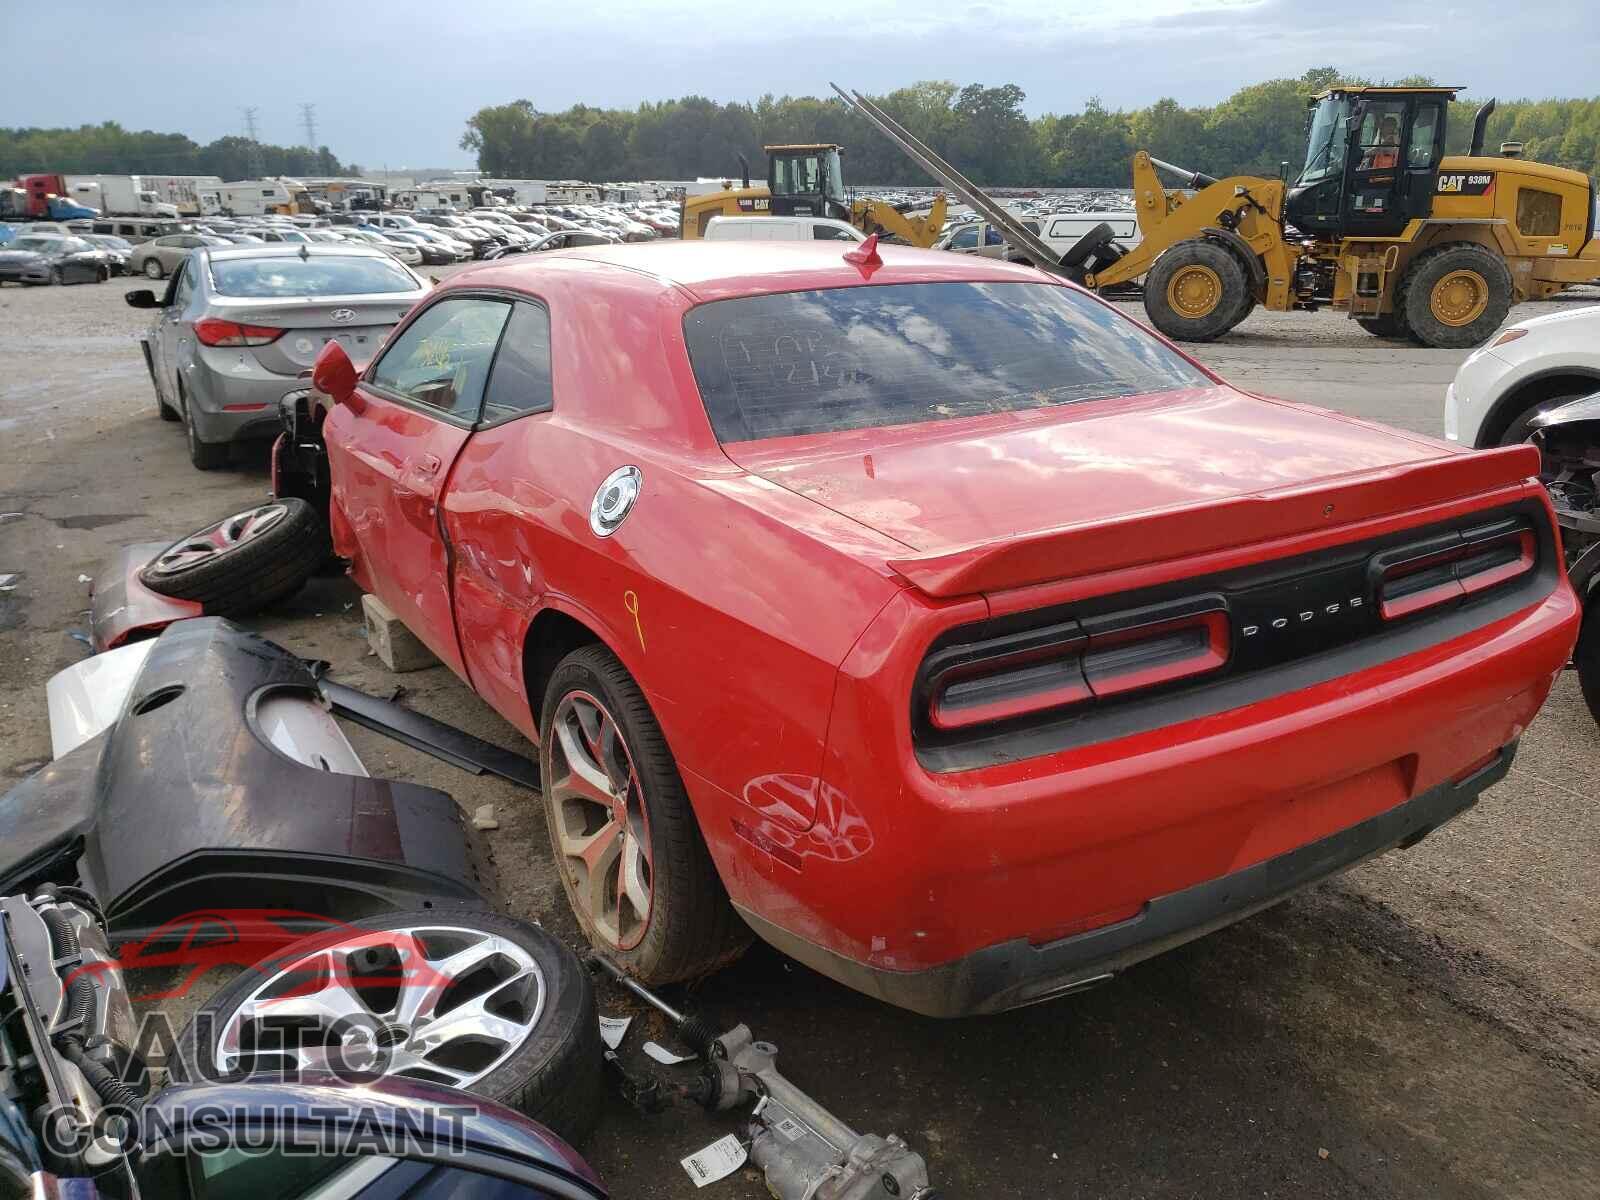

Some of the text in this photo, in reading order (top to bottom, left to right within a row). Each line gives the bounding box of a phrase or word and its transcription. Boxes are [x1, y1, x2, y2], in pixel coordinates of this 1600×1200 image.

[1437, 175, 1491, 191] CAT 938M
[754, 199, 769, 210] CAT
[1243, 597, 1362, 636] DODGE
